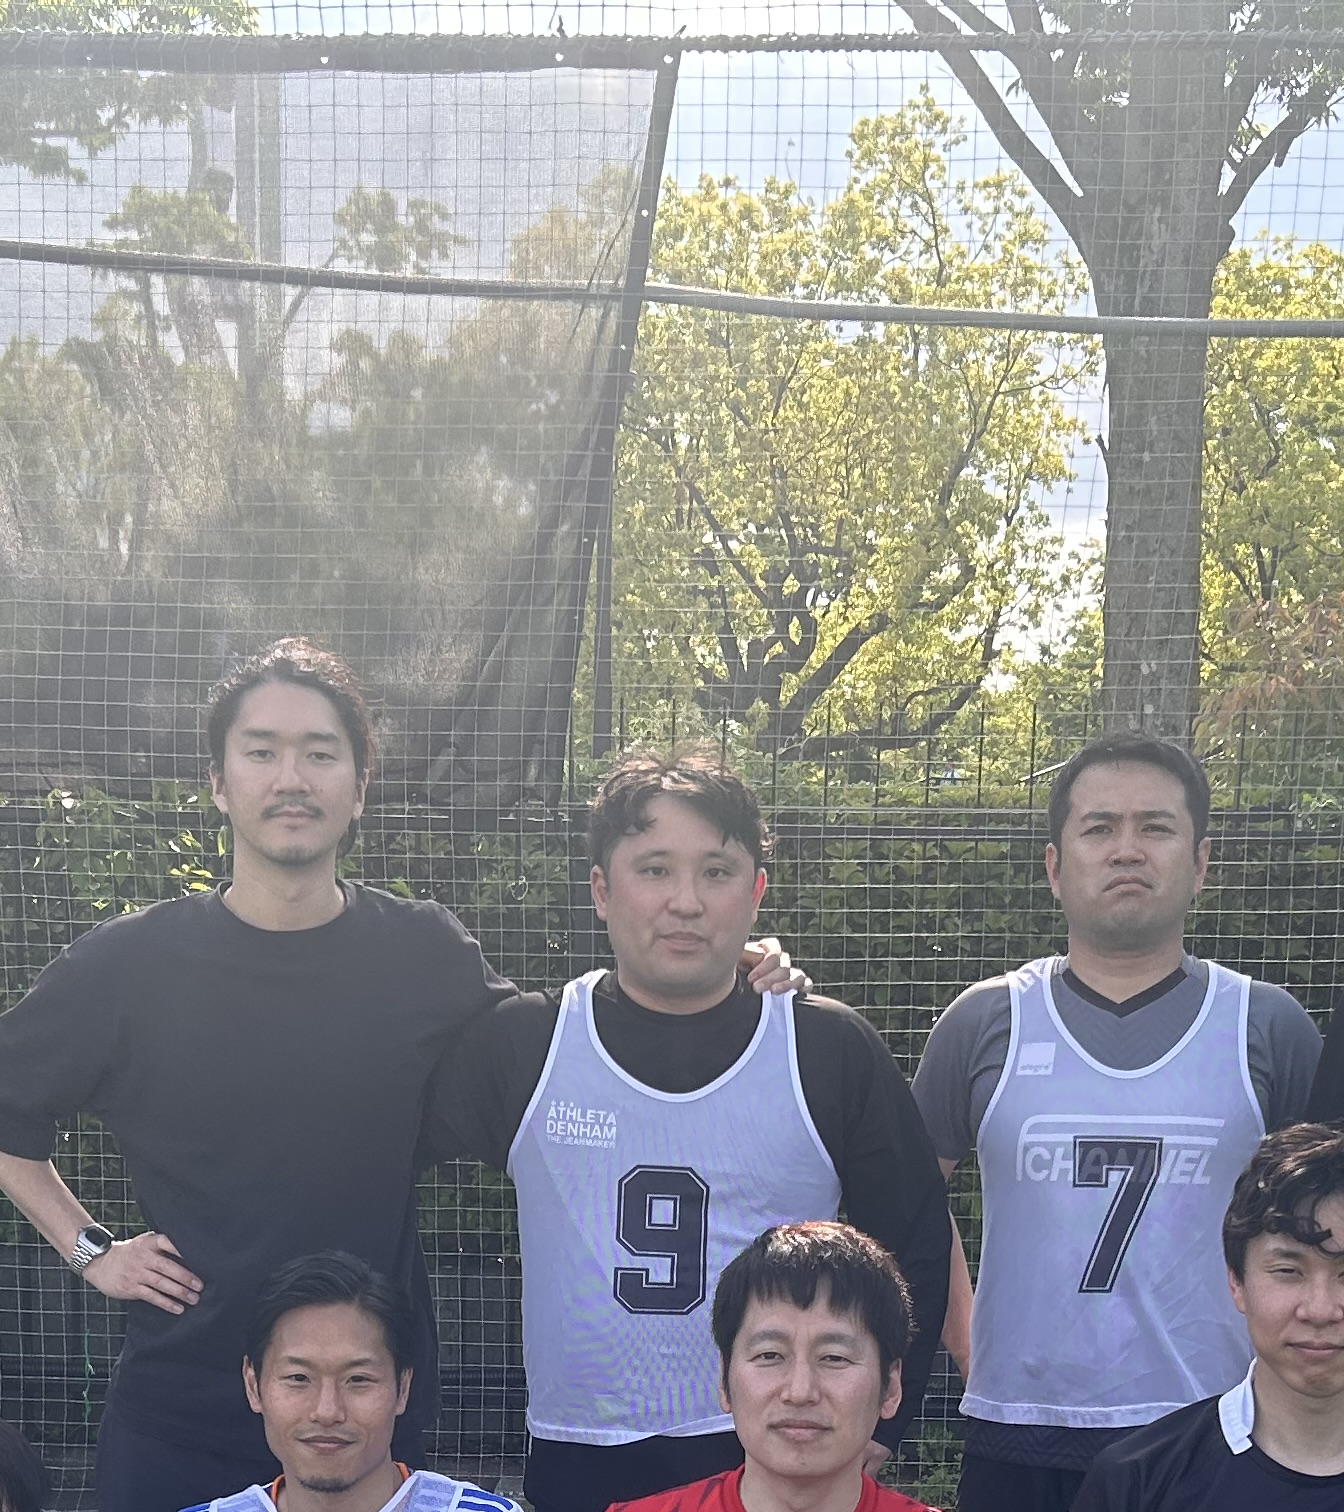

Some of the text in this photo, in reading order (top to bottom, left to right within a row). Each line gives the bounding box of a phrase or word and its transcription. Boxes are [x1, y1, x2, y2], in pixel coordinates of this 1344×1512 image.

[546, 1119, 617, 1140] DENHAM
[547, 1102, 617, 1125] ATHLETA
[613, 1164, 710, 1316] 9
[1072, 1135, 1164, 1294] 7
